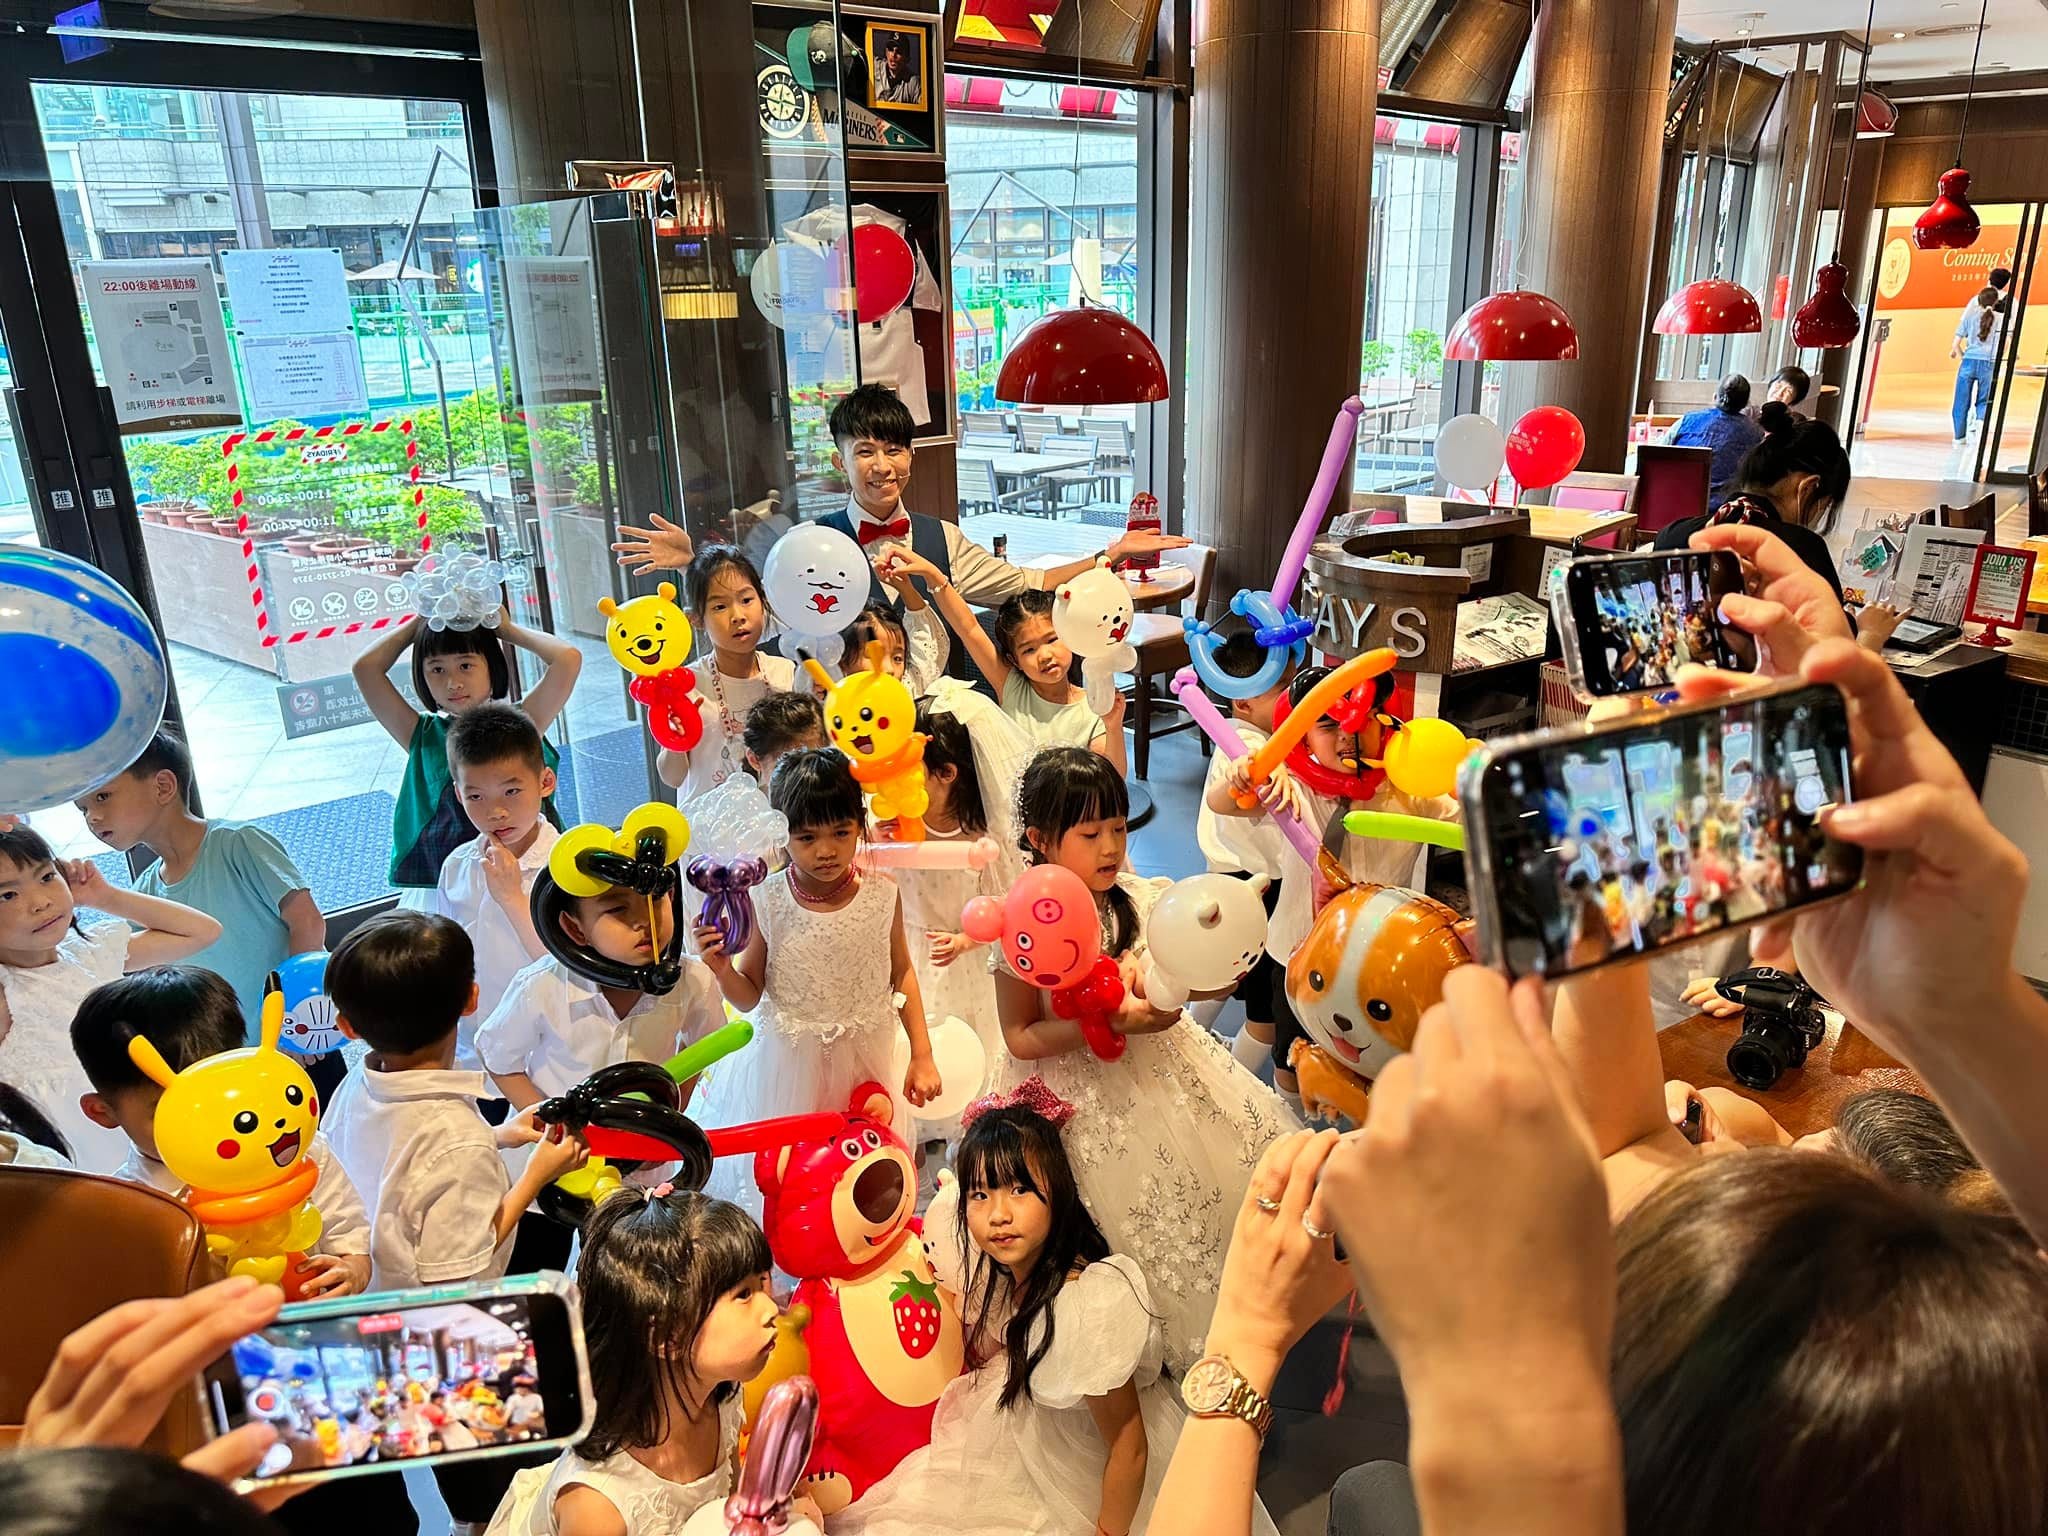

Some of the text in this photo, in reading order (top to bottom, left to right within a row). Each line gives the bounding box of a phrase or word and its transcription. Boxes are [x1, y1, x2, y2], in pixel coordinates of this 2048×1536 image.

[1944, 248, 2000, 272] Coming
[55, 491, 70, 504] 推
[96, 490, 112, 502] 推
